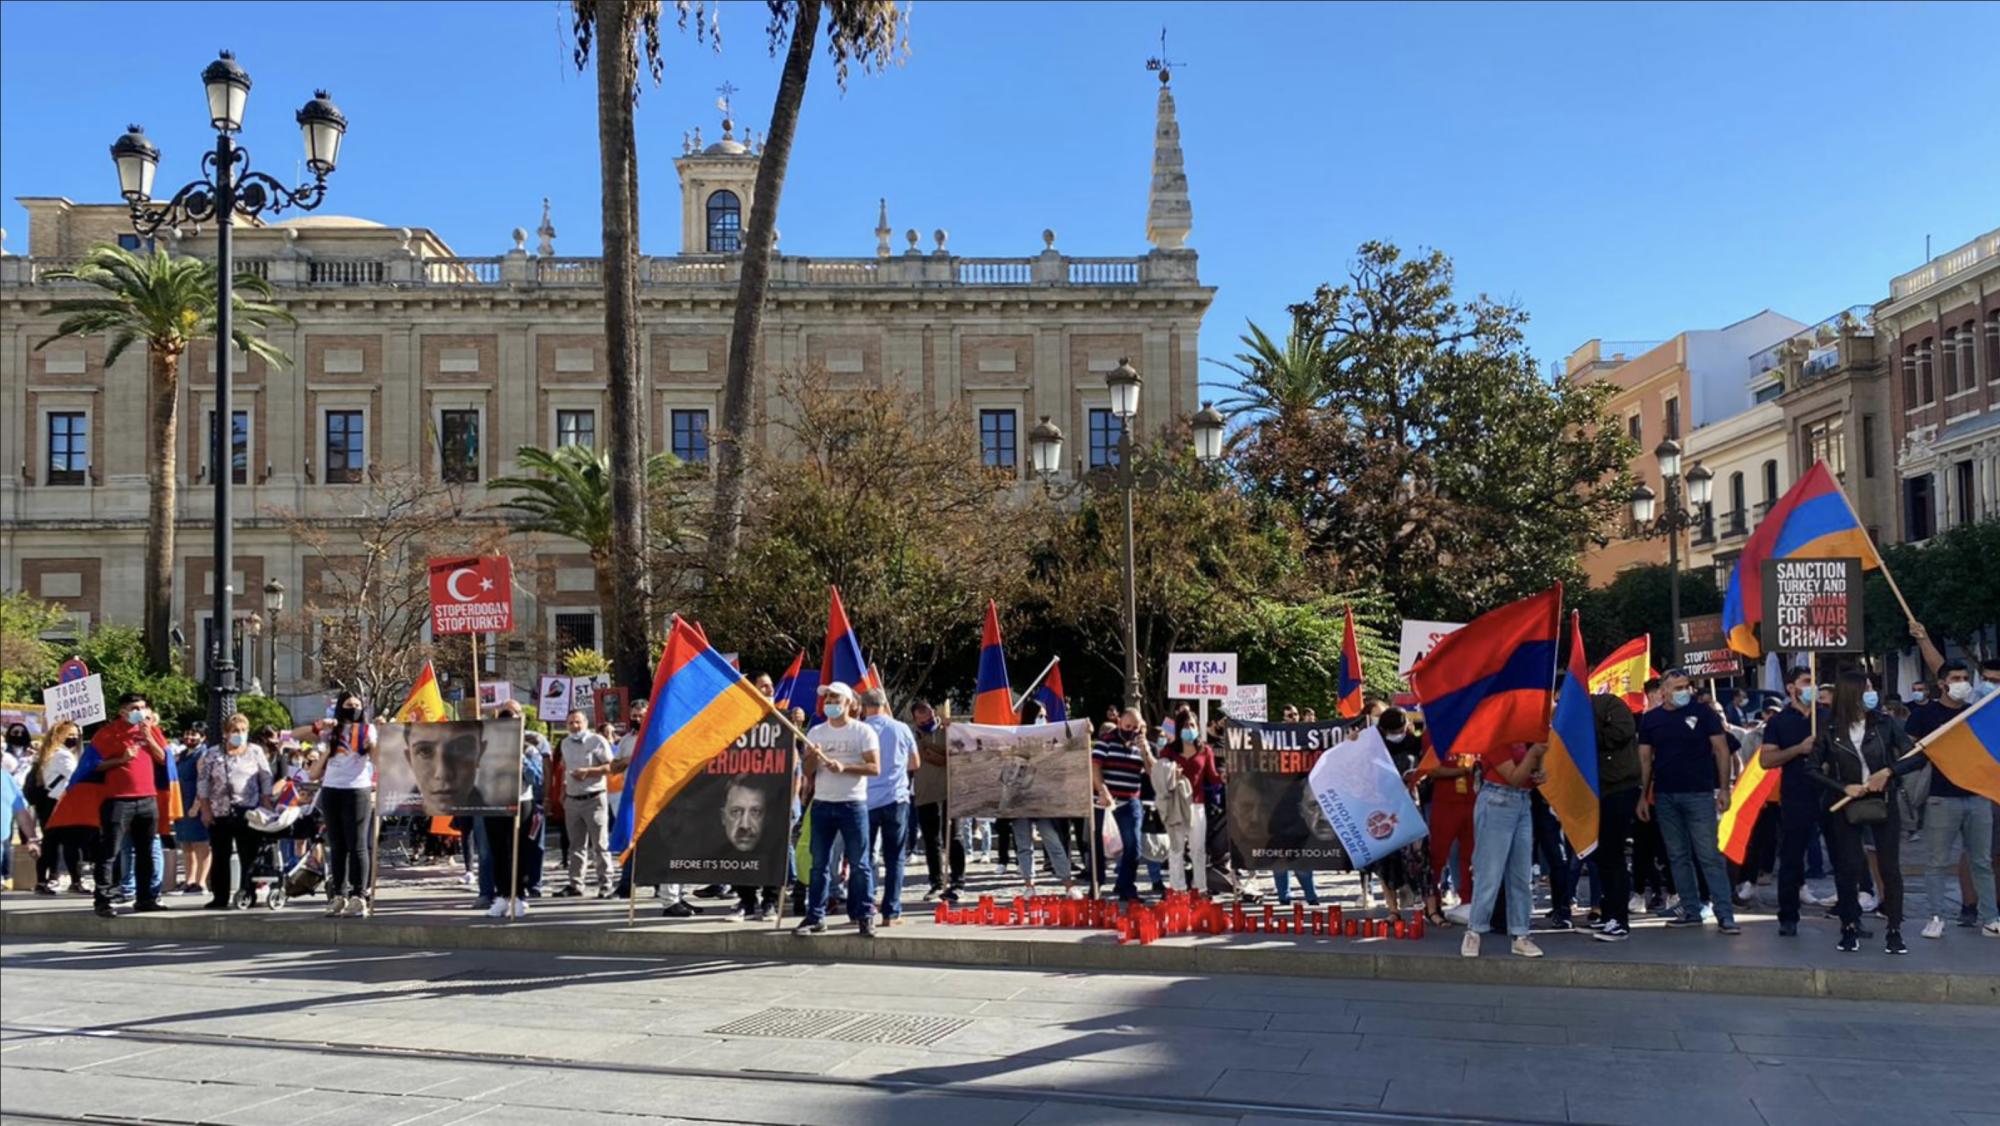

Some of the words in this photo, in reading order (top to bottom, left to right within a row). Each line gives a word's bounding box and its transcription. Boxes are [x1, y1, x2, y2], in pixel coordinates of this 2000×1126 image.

[1777, 562, 1845, 579] SANCTION
[1777, 579, 1820, 592] TURKEY
[1823, 579, 1846, 592] AND
[1778, 592, 1847, 606] AZERBAIJAN
[435, 602, 509, 618] STOPERDOGAN
[1778, 607, 1808, 625] FOR
[1812, 607, 1847, 625] WAR
[437, 615, 508, 632] STOPTURKEY
[1778, 625, 1848, 647] CRIMES
[1179, 661, 1227, 674] ARTSAJ
[1194, 674, 1209, 684] ES
[55, 680, 87, 698] TODOS
[1179, 683, 1228, 695] NUESTRO
[57, 693, 90, 711] SOMOS
[1227, 727, 1253, 750] WE
[1260, 729, 1301, 751] WILL
[1307, 726, 1345, 749] STO
[1318, 793, 1334, 814] #YES
[1331, 813, 1346, 829] WE
[1340, 830, 1360, 855] CARE
[1335, 801, 1351, 822] NOS
[1347, 822, 1373, 863] IMPORTA
[1251, 848, 1284, 858] BEFORE
[1285, 848, 1300, 858] IT'S
[1301, 848, 1321, 858] TOO
[1322, 848, 1340, 858] LATE
[669, 859, 702, 870] BEFORE
[702, 859, 718, 870] IT'S
[719, 859, 739, 870] TOO
[740, 860, 759, 870] LATE
